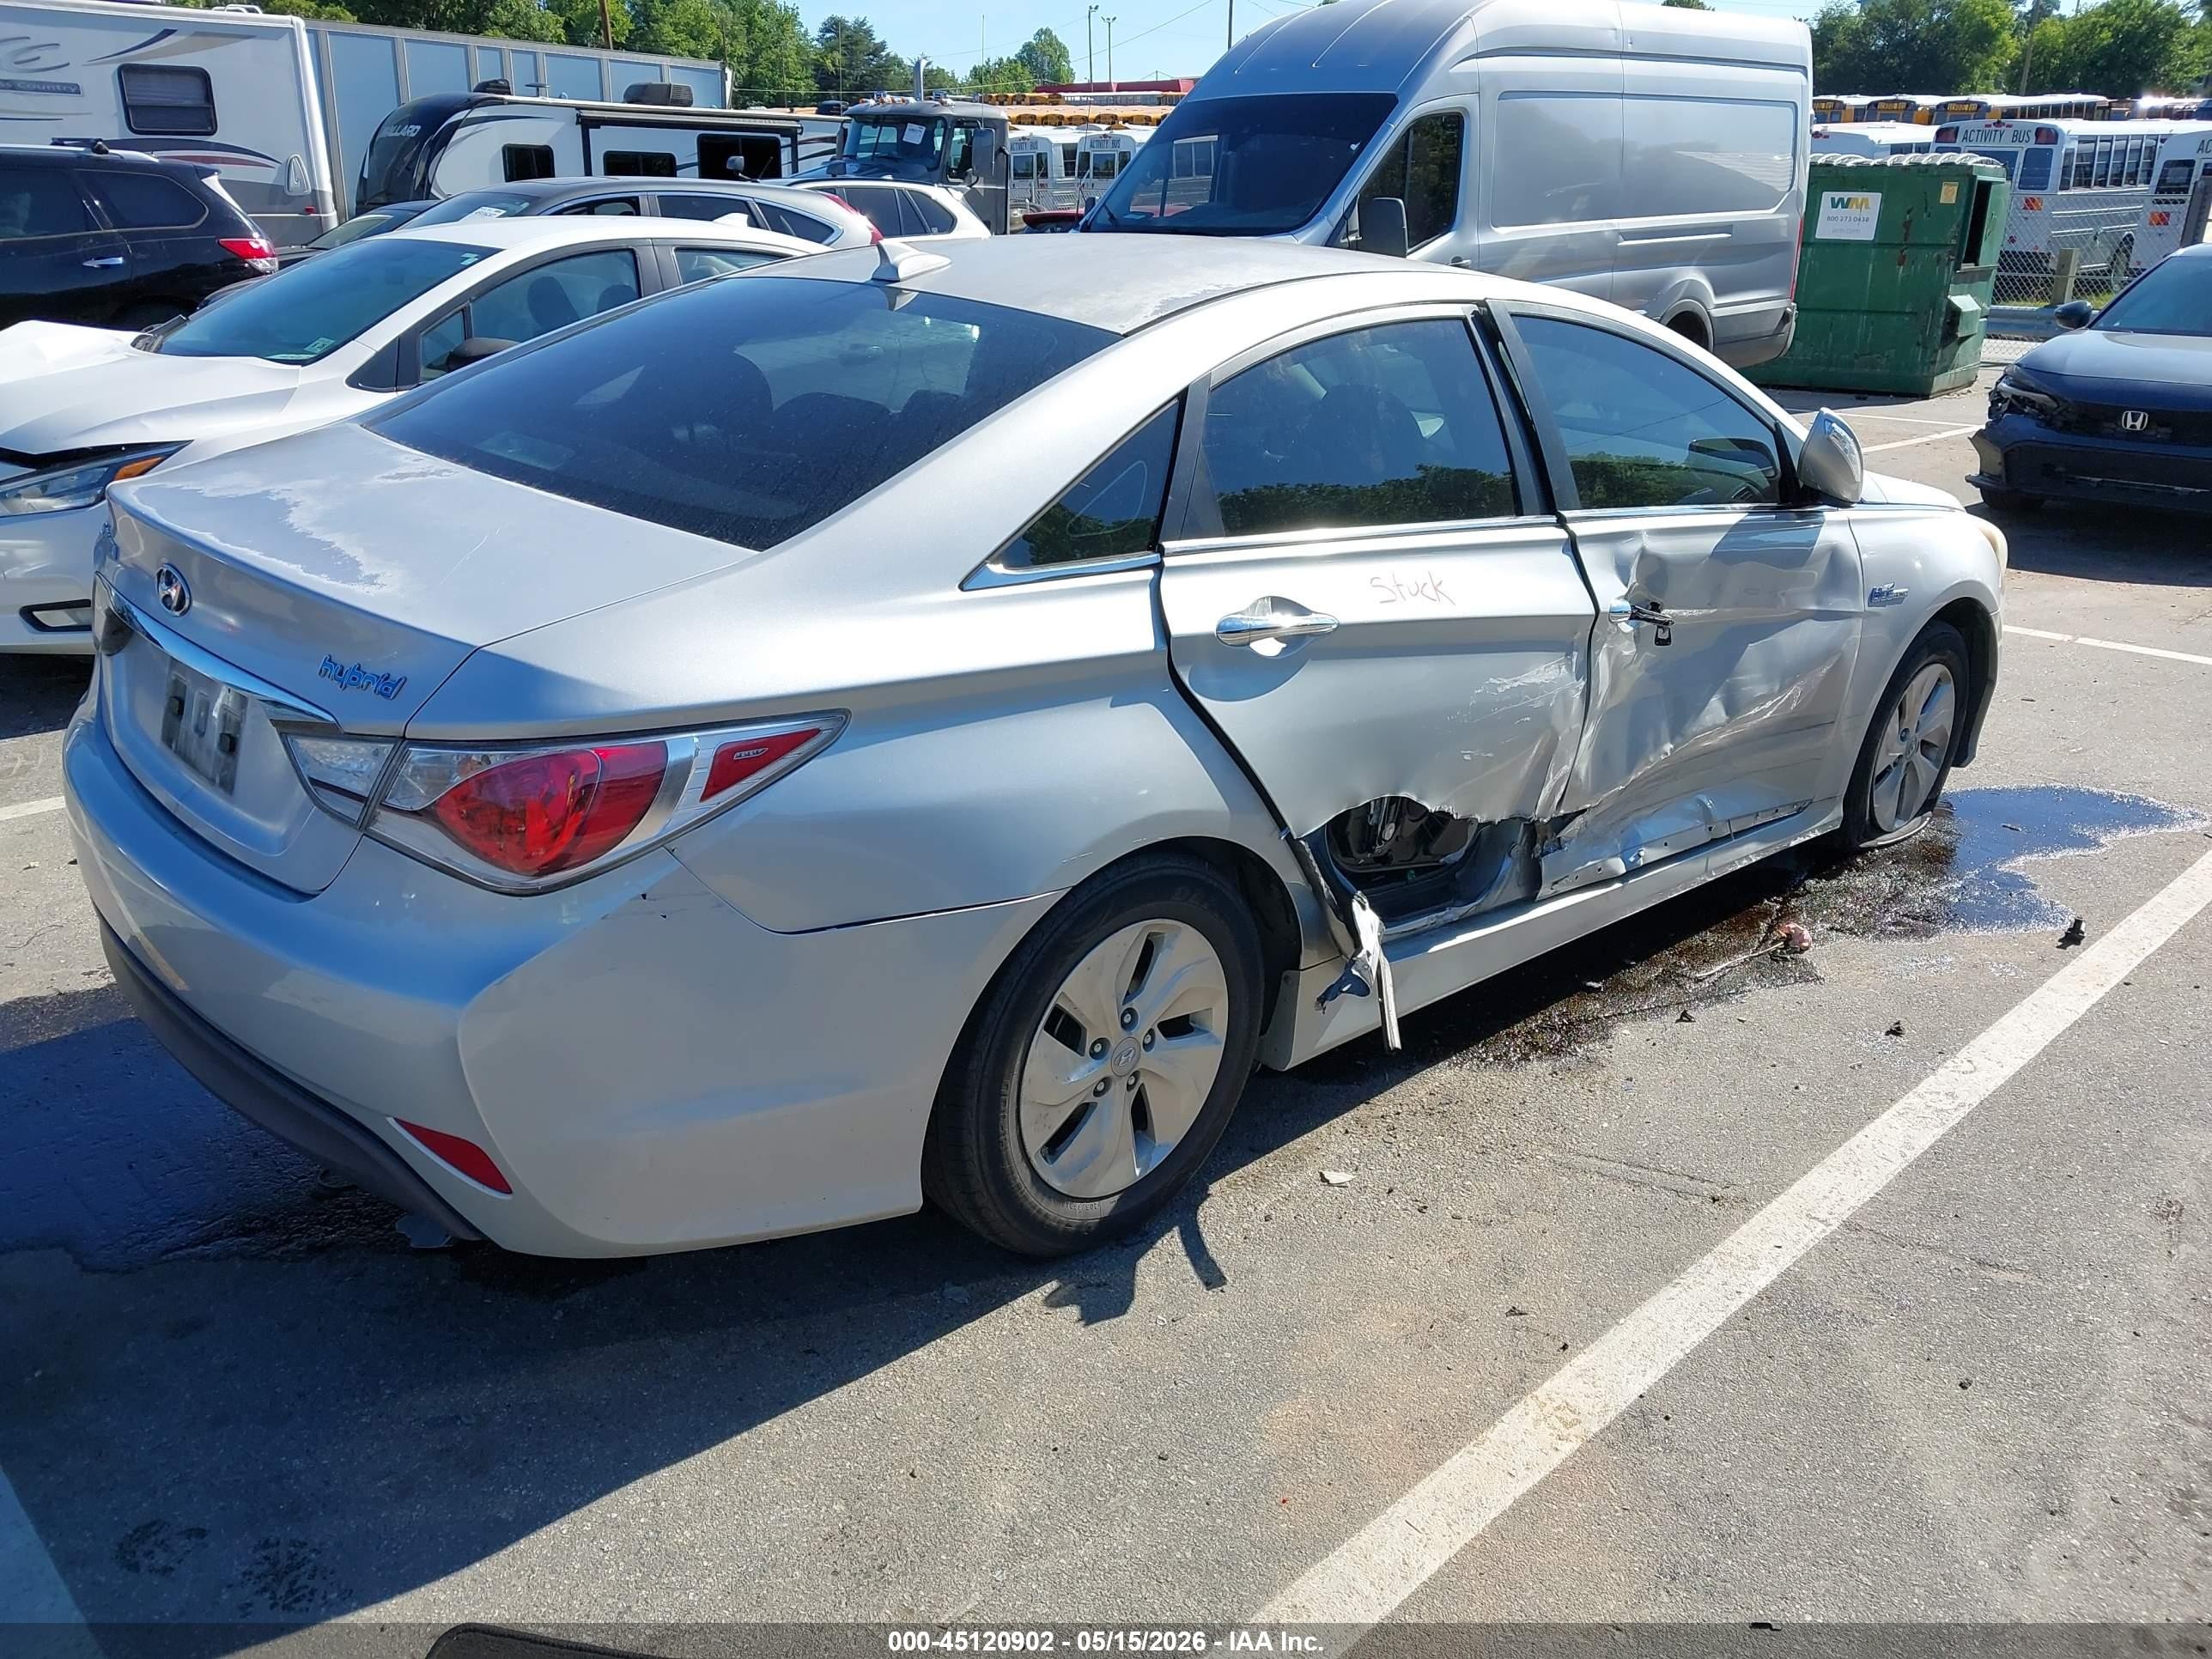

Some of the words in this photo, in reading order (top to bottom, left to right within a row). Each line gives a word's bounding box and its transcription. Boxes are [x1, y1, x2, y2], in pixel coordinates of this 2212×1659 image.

[17, 82, 77, 93] Country
[1961, 130, 2006, 143] ACTIVITY
[2011, 130, 2032, 143] BUS
[1010, 142, 1028, 152] ACTIVITY
[1030, 141, 1038, 150] BUS
[1091, 139, 1109, 149] ACTIVITY
[1111, 139, 1121, 149] BUS
[1830, 197, 1869, 210] WM
[318, 653, 408, 701] hybrid
